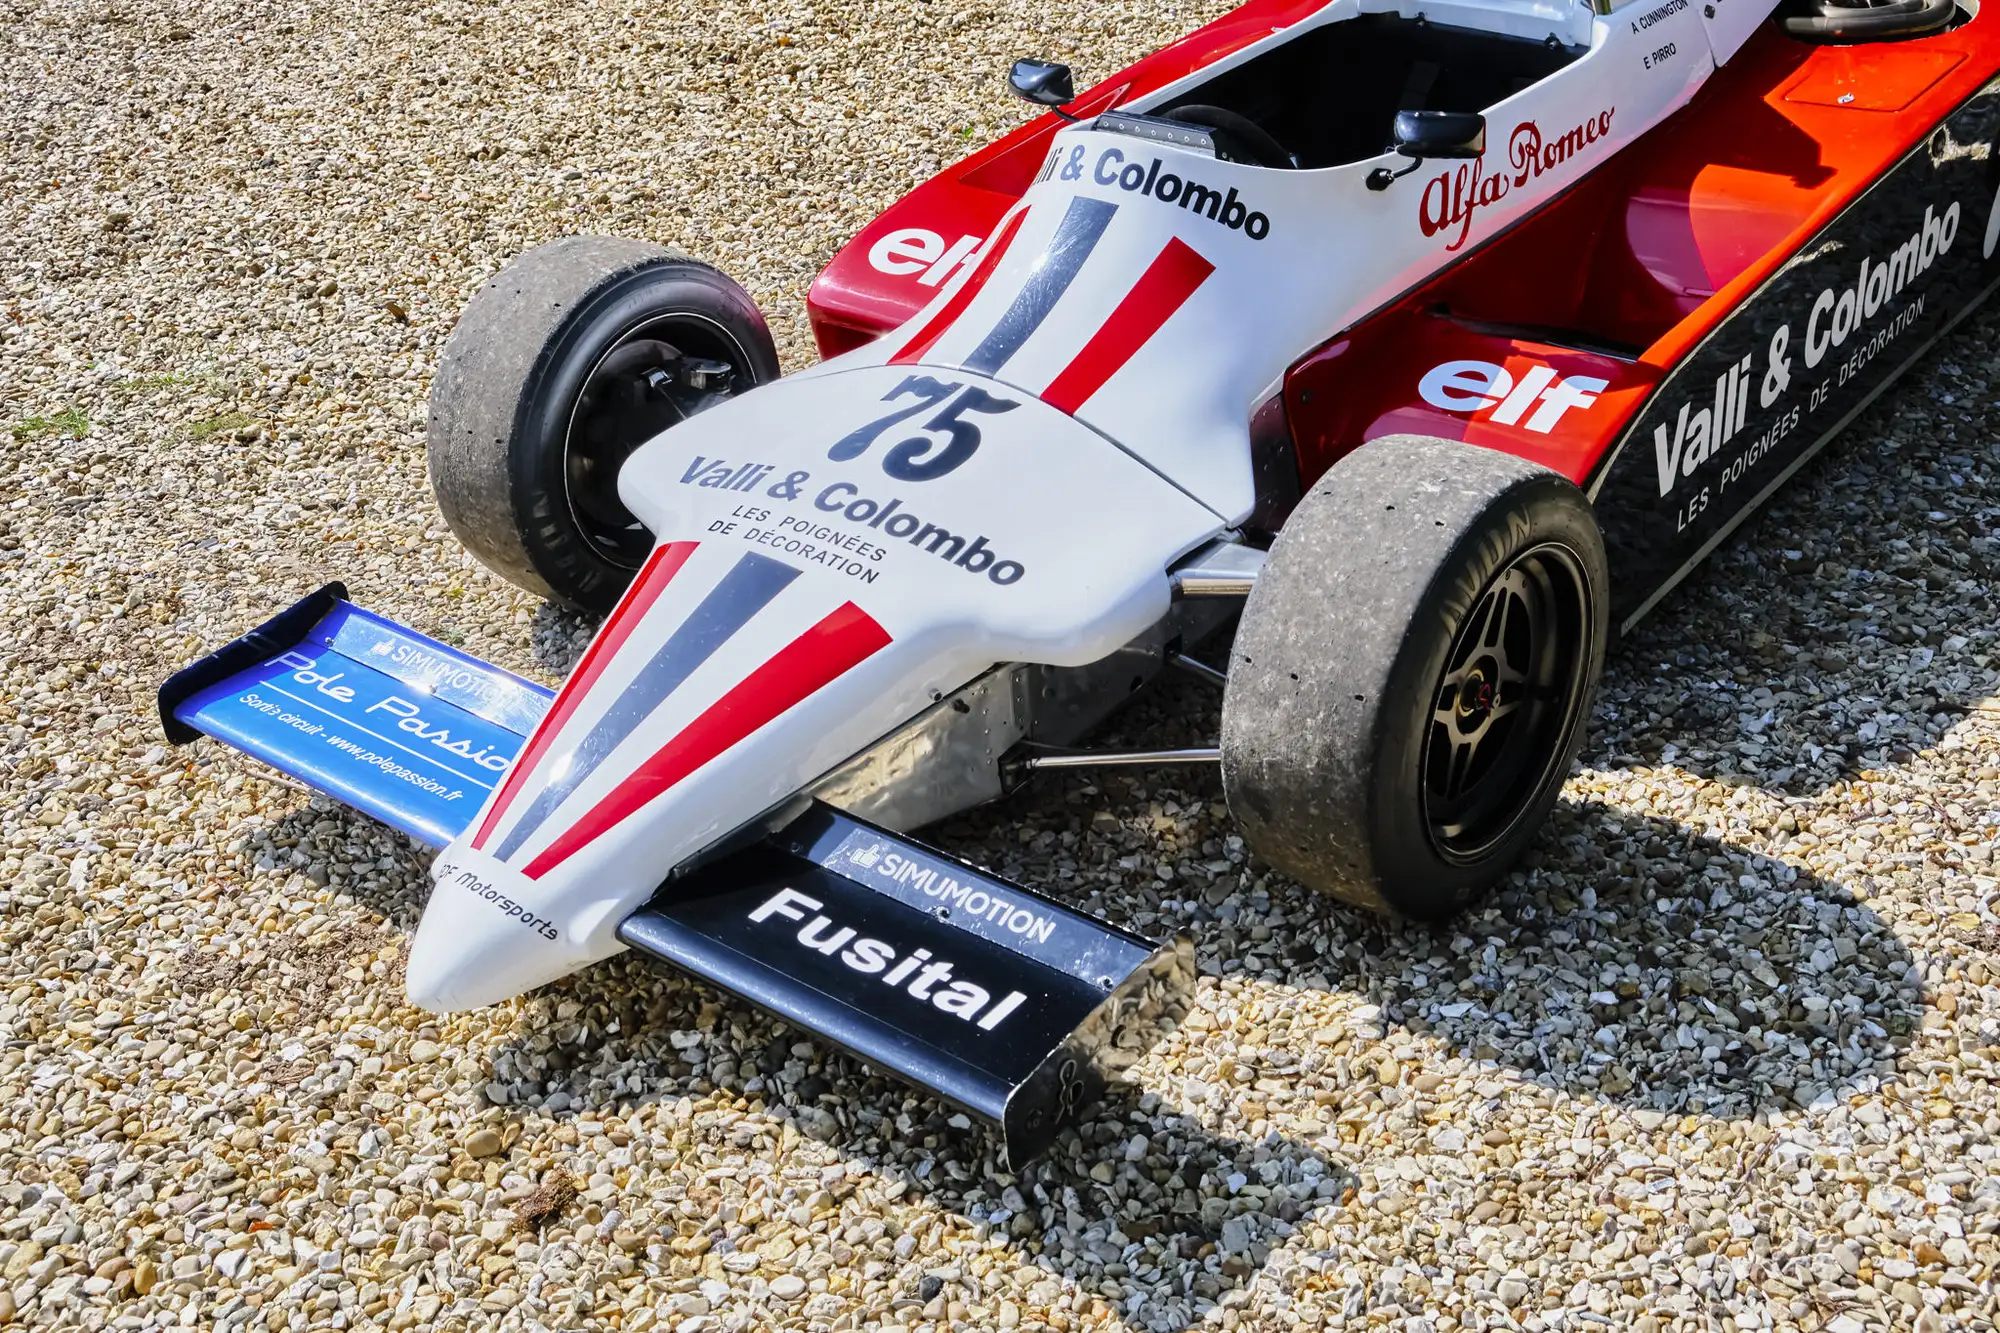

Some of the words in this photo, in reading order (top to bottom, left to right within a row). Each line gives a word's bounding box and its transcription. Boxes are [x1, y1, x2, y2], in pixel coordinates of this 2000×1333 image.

[1640, 0, 1689, 29] CUNNINGTON
[1643, 56, 1651, 70] E
[1651, 42, 1677, 66] PIRRO
[1059, 144, 1086, 182] &
[1094, 148, 1270, 241] Colombo
[1419, 156, 1510, 251] Alfa
[1508, 106, 1615, 188] Romeo
[1418, 359, 1610, 434] elf
[1653, 352, 1752, 499] Valli
[1760, 324, 1792, 409] &
[1804, 201, 1961, 370] Colombo
[827, 374, 1022, 482] 75
[1676, 486, 1709, 534] LES
[1720, 404, 1800, 494] POIGNÉES
[1809, 378, 1829, 415] DE
[1838, 293, 1926, 387] DÉCORATION
[679, 455, 775, 494] Valli
[766, 470, 810, 502] &
[813, 481, 1026, 586] Colombo
[707, 519, 738, 537] DE
[744, 523, 881, 585] DÉCORATION
[731, 504, 771, 523] LES
[779, 514, 887, 563] POIGNÉES
[264, 651, 356, 704] Pole
[365, 695, 509, 771] Passio
[277, 711, 325, 737] circuit
[326, 735, 464, 802] www.polepassion.fr
[455, 872, 558, 940] Motorsports
[877, 852, 1057, 943] SIMUMOTION
[747, 887, 1028, 1031] Fusital
